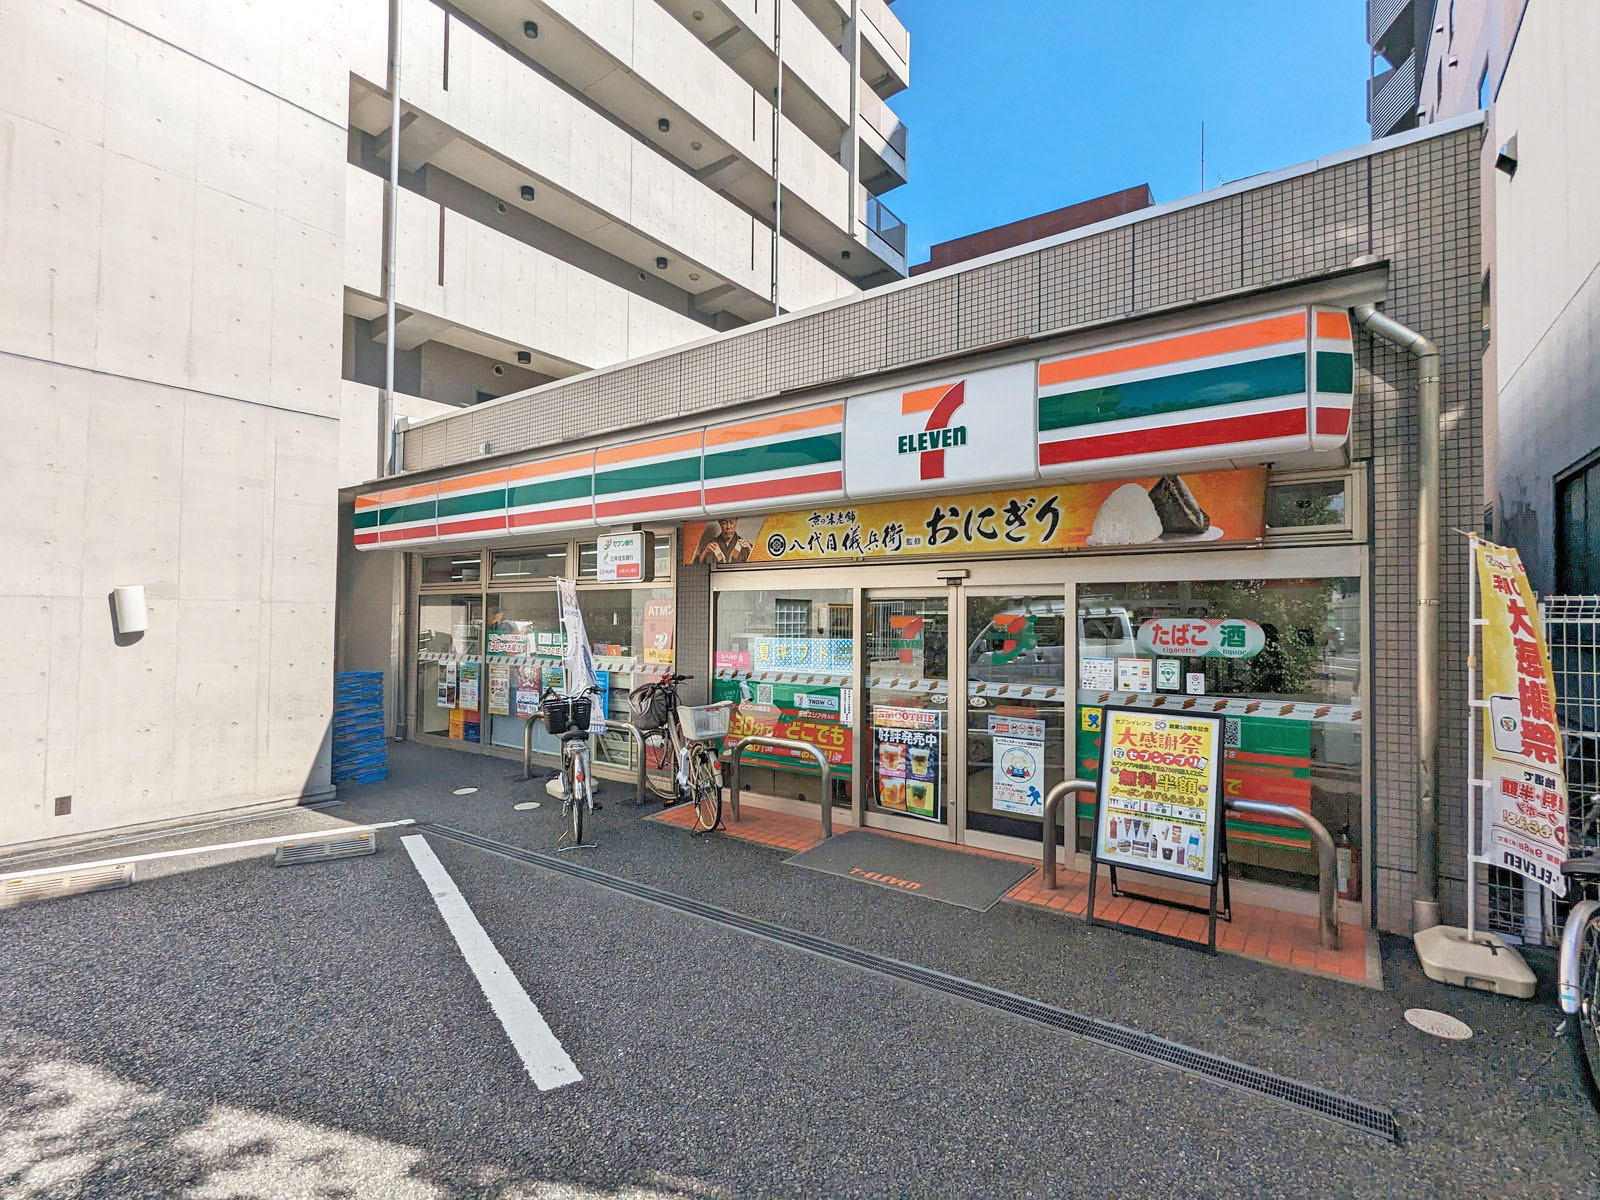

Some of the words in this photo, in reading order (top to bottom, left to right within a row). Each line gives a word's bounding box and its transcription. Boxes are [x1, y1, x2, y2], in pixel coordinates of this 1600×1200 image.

[926, 495, 1061, 546] おにぎり
[1151, 623, 1209, 647] たばこ
[1219, 625, 1247, 648] 酒
[757, 642, 828, 664] 夏ギフト
[1162, 647, 1197, 655] cigarette
[1222, 648, 1247, 657] liquor
[878, 709, 936, 723] SMOOTHIE
[785, 721, 845, 745] どこでも
[878, 728, 937, 747] 好評発売中
[1117, 726, 1203, 755] 大感謝祭
[1127, 750, 1199, 768] セブンアプリ
